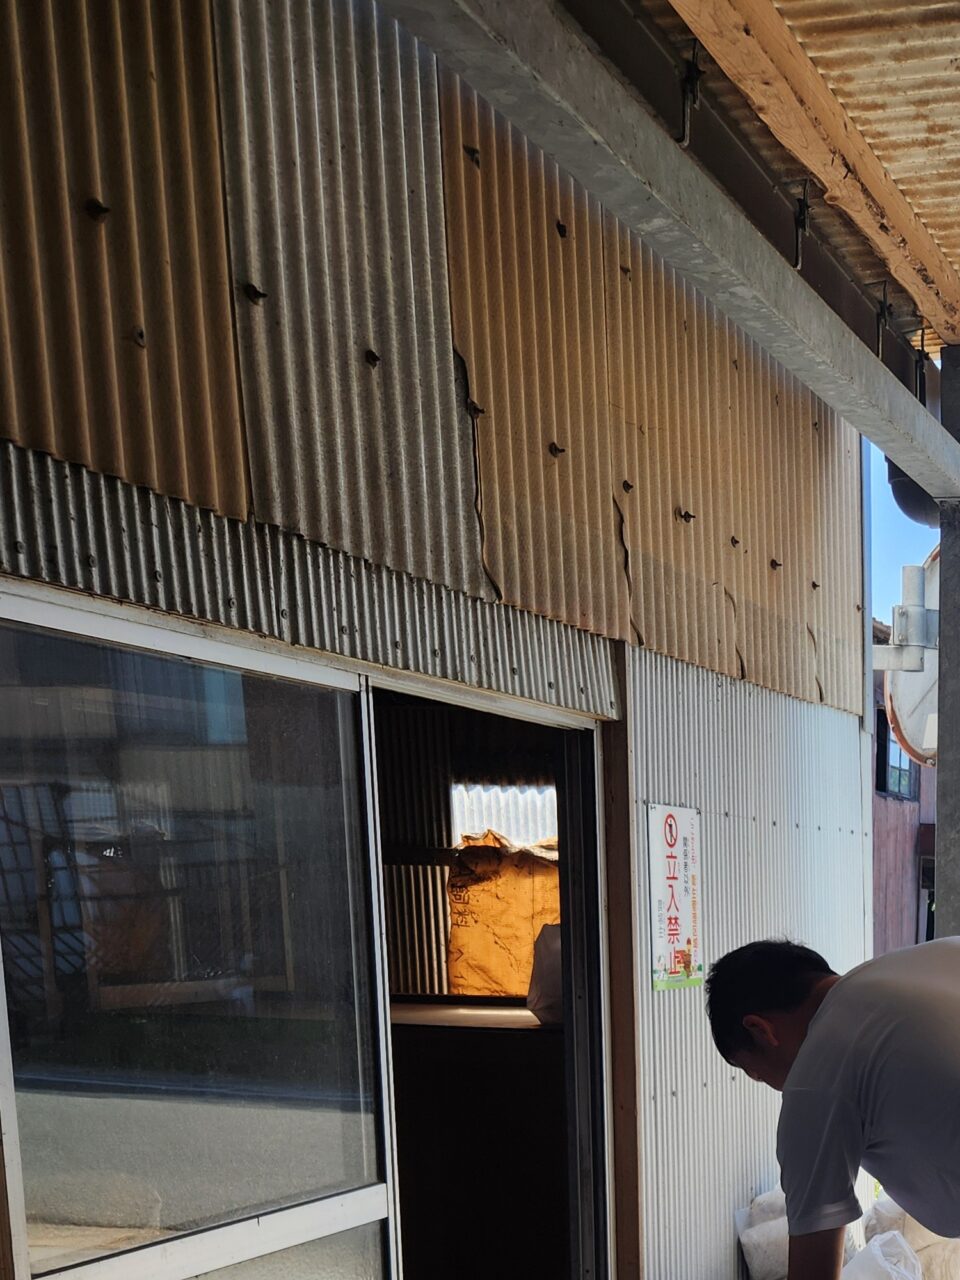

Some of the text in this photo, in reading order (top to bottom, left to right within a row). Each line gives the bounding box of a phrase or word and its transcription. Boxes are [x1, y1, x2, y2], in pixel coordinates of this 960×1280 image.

[451, 884, 470, 928] 飼料
[666, 852, 681, 975] 立入禁止
